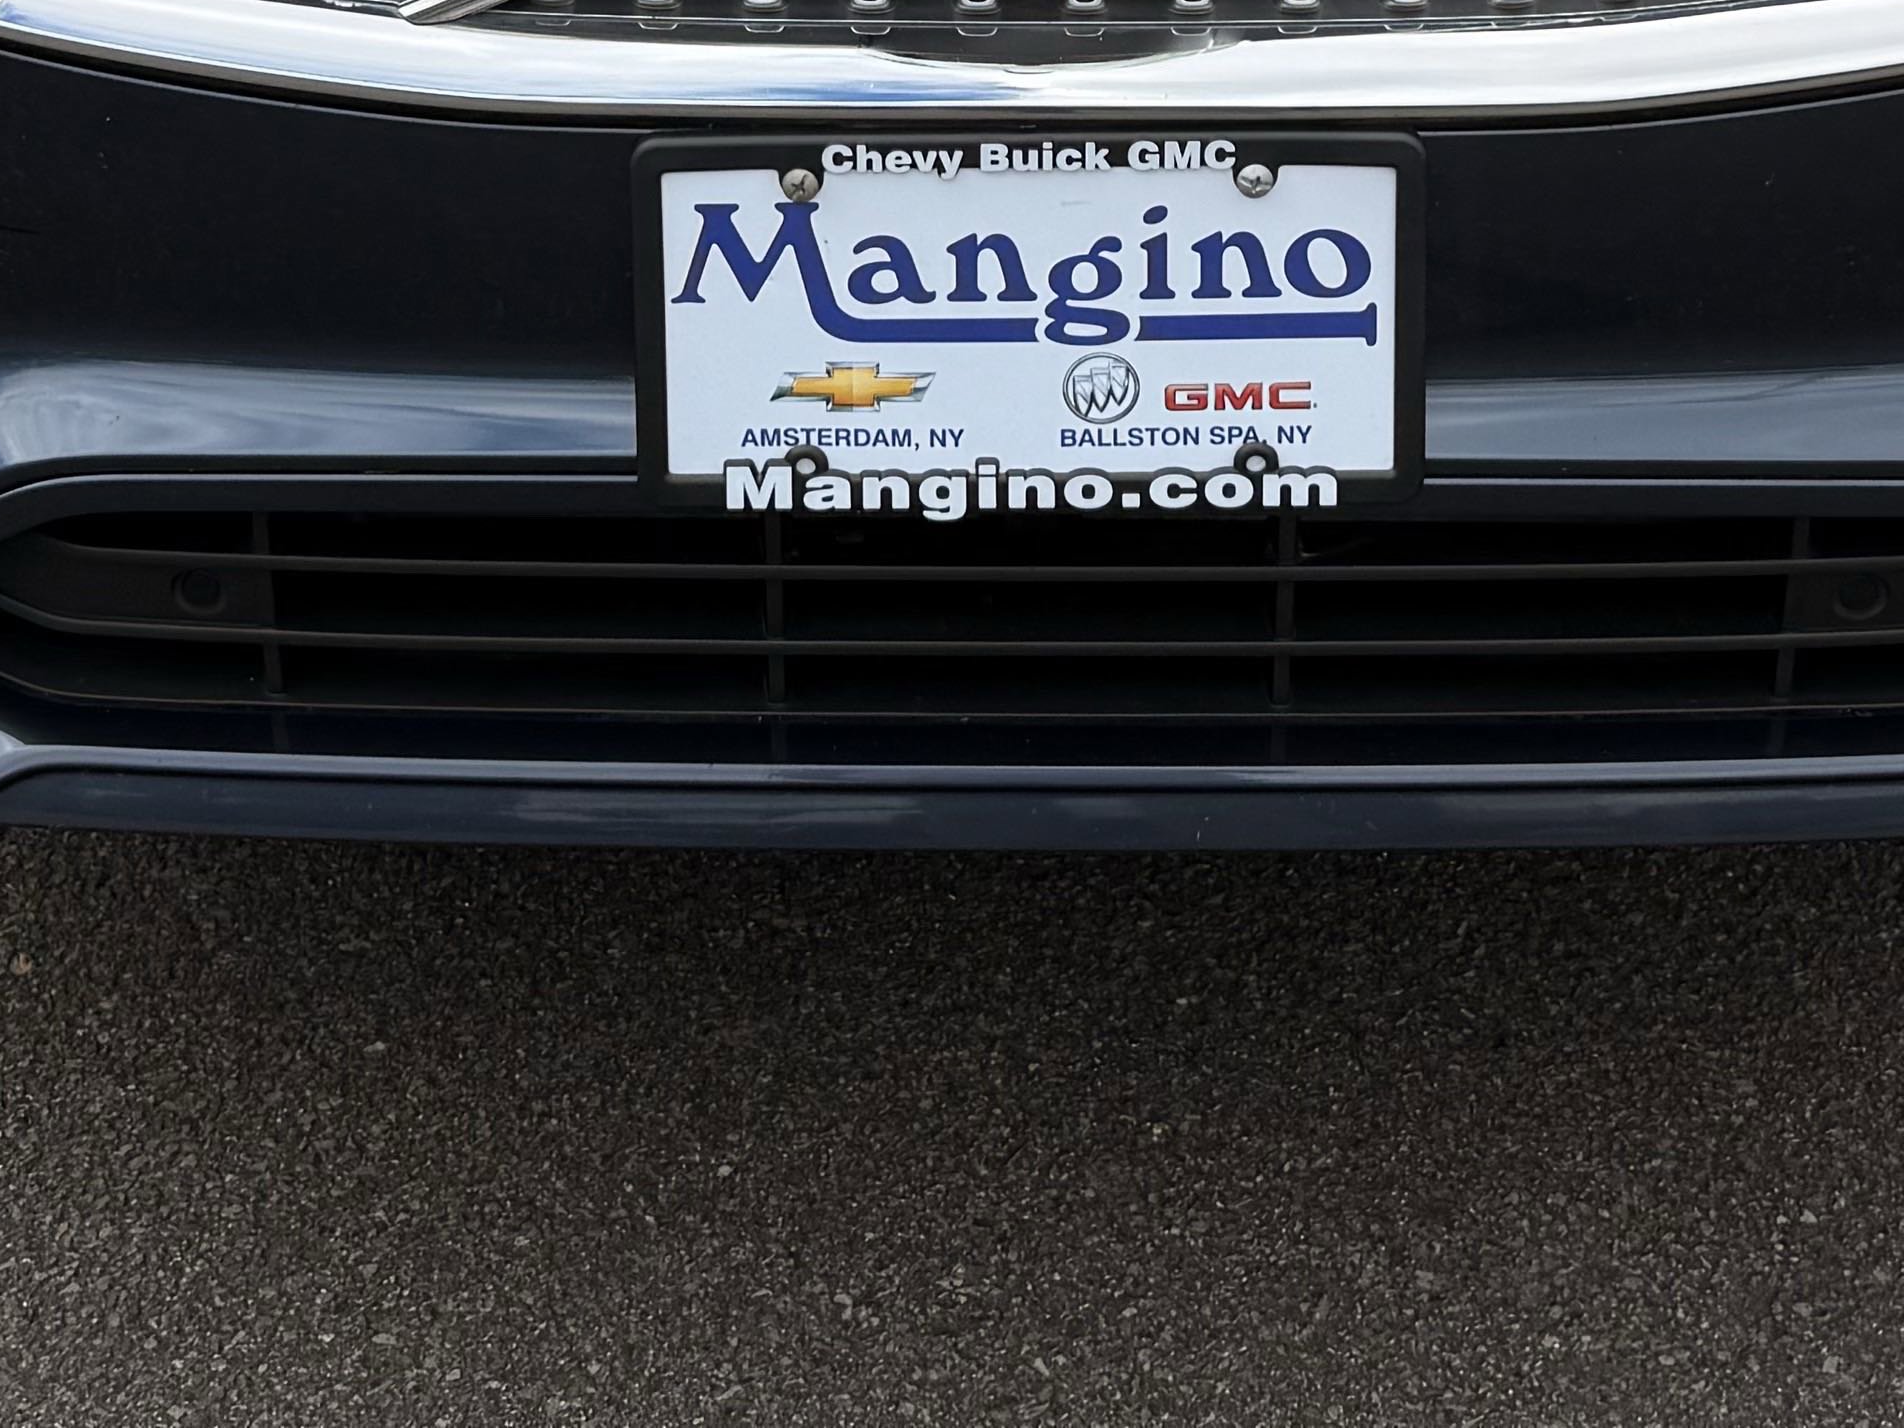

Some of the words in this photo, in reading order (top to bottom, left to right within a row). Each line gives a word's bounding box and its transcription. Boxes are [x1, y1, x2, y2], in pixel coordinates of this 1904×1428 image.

[821, 144, 963, 181] Chevy
[979, 142, 1113, 173] Buick
[1127, 140, 1236, 171] GMC
[671, 201, 1377, 346] Mangino
[1164, 381, 1312, 411] GMC
[741, 427, 920, 451] AMSTERDAM,
[930, 428, 964, 447] NY
[1060, 426, 1200, 448] BALLSTON
[1277, 425, 1312, 445] NY
[724, 463, 1338, 522] Mangino.com
